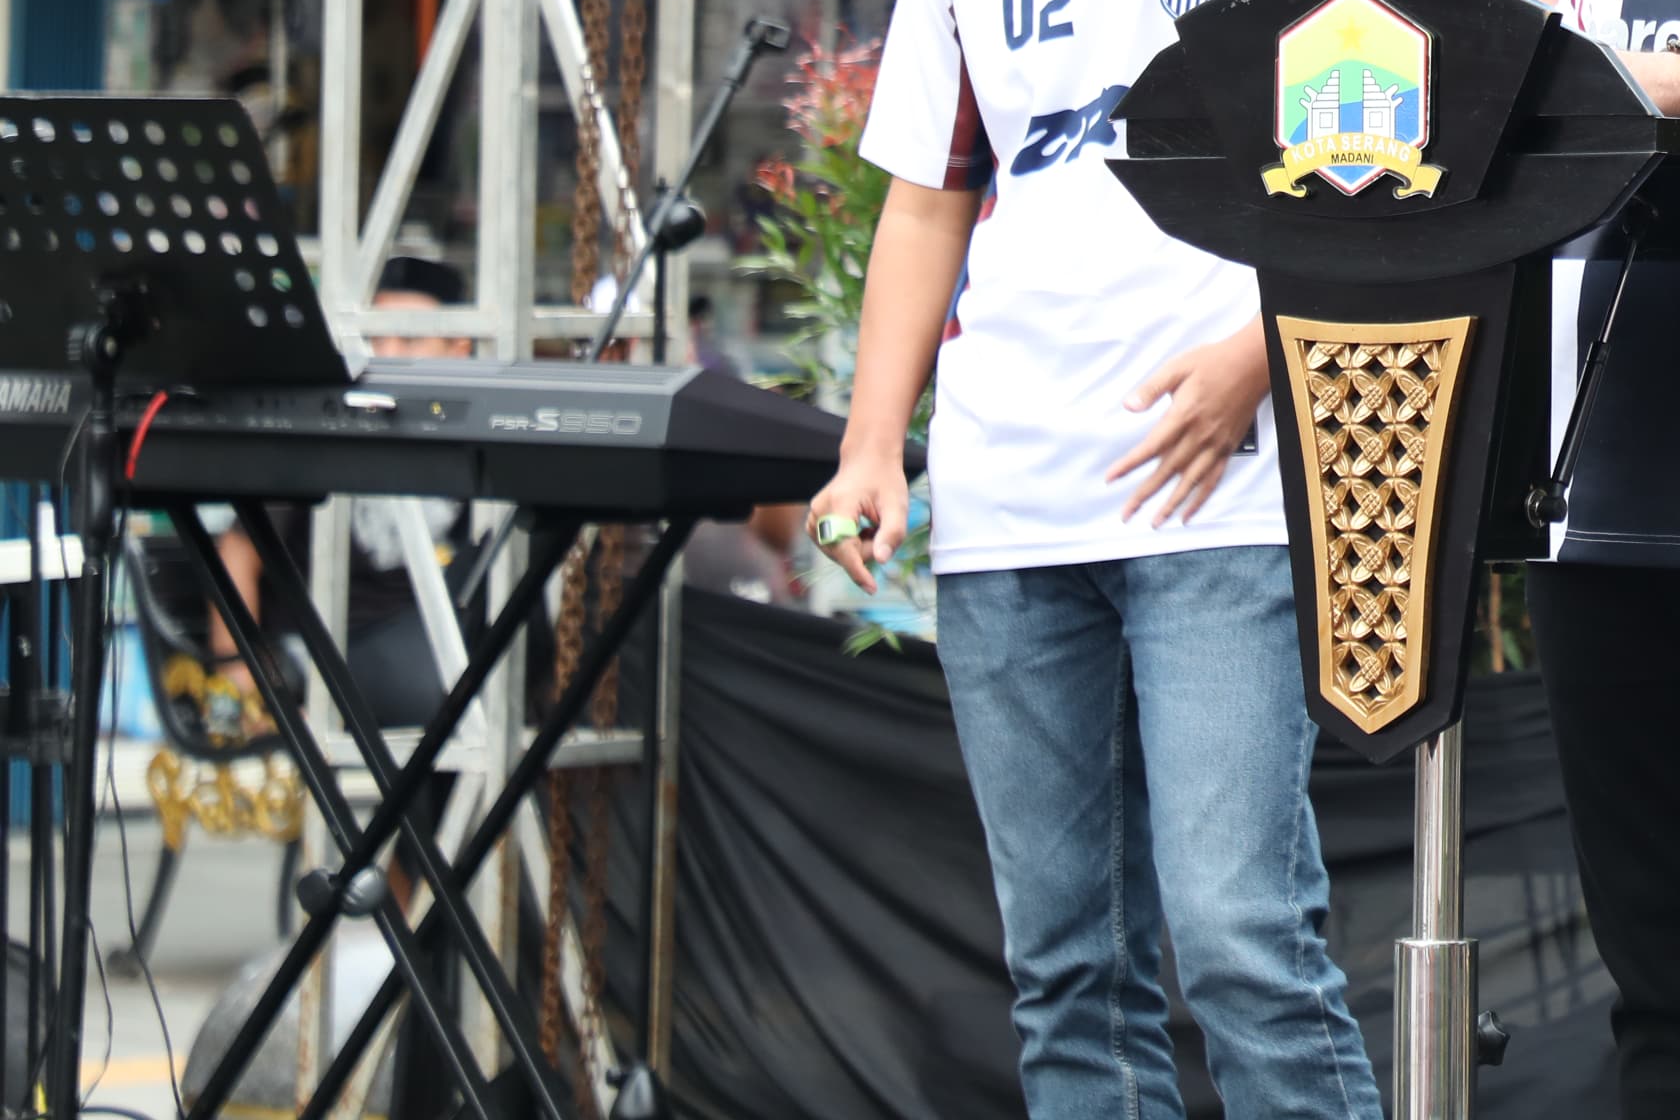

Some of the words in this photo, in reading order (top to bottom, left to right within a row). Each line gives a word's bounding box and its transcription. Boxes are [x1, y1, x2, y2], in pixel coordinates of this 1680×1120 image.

[1291, 138, 1337, 164] KOTA
[1341, 134, 1412, 162] SERANG
[1331, 153, 1375, 165] MADANI
